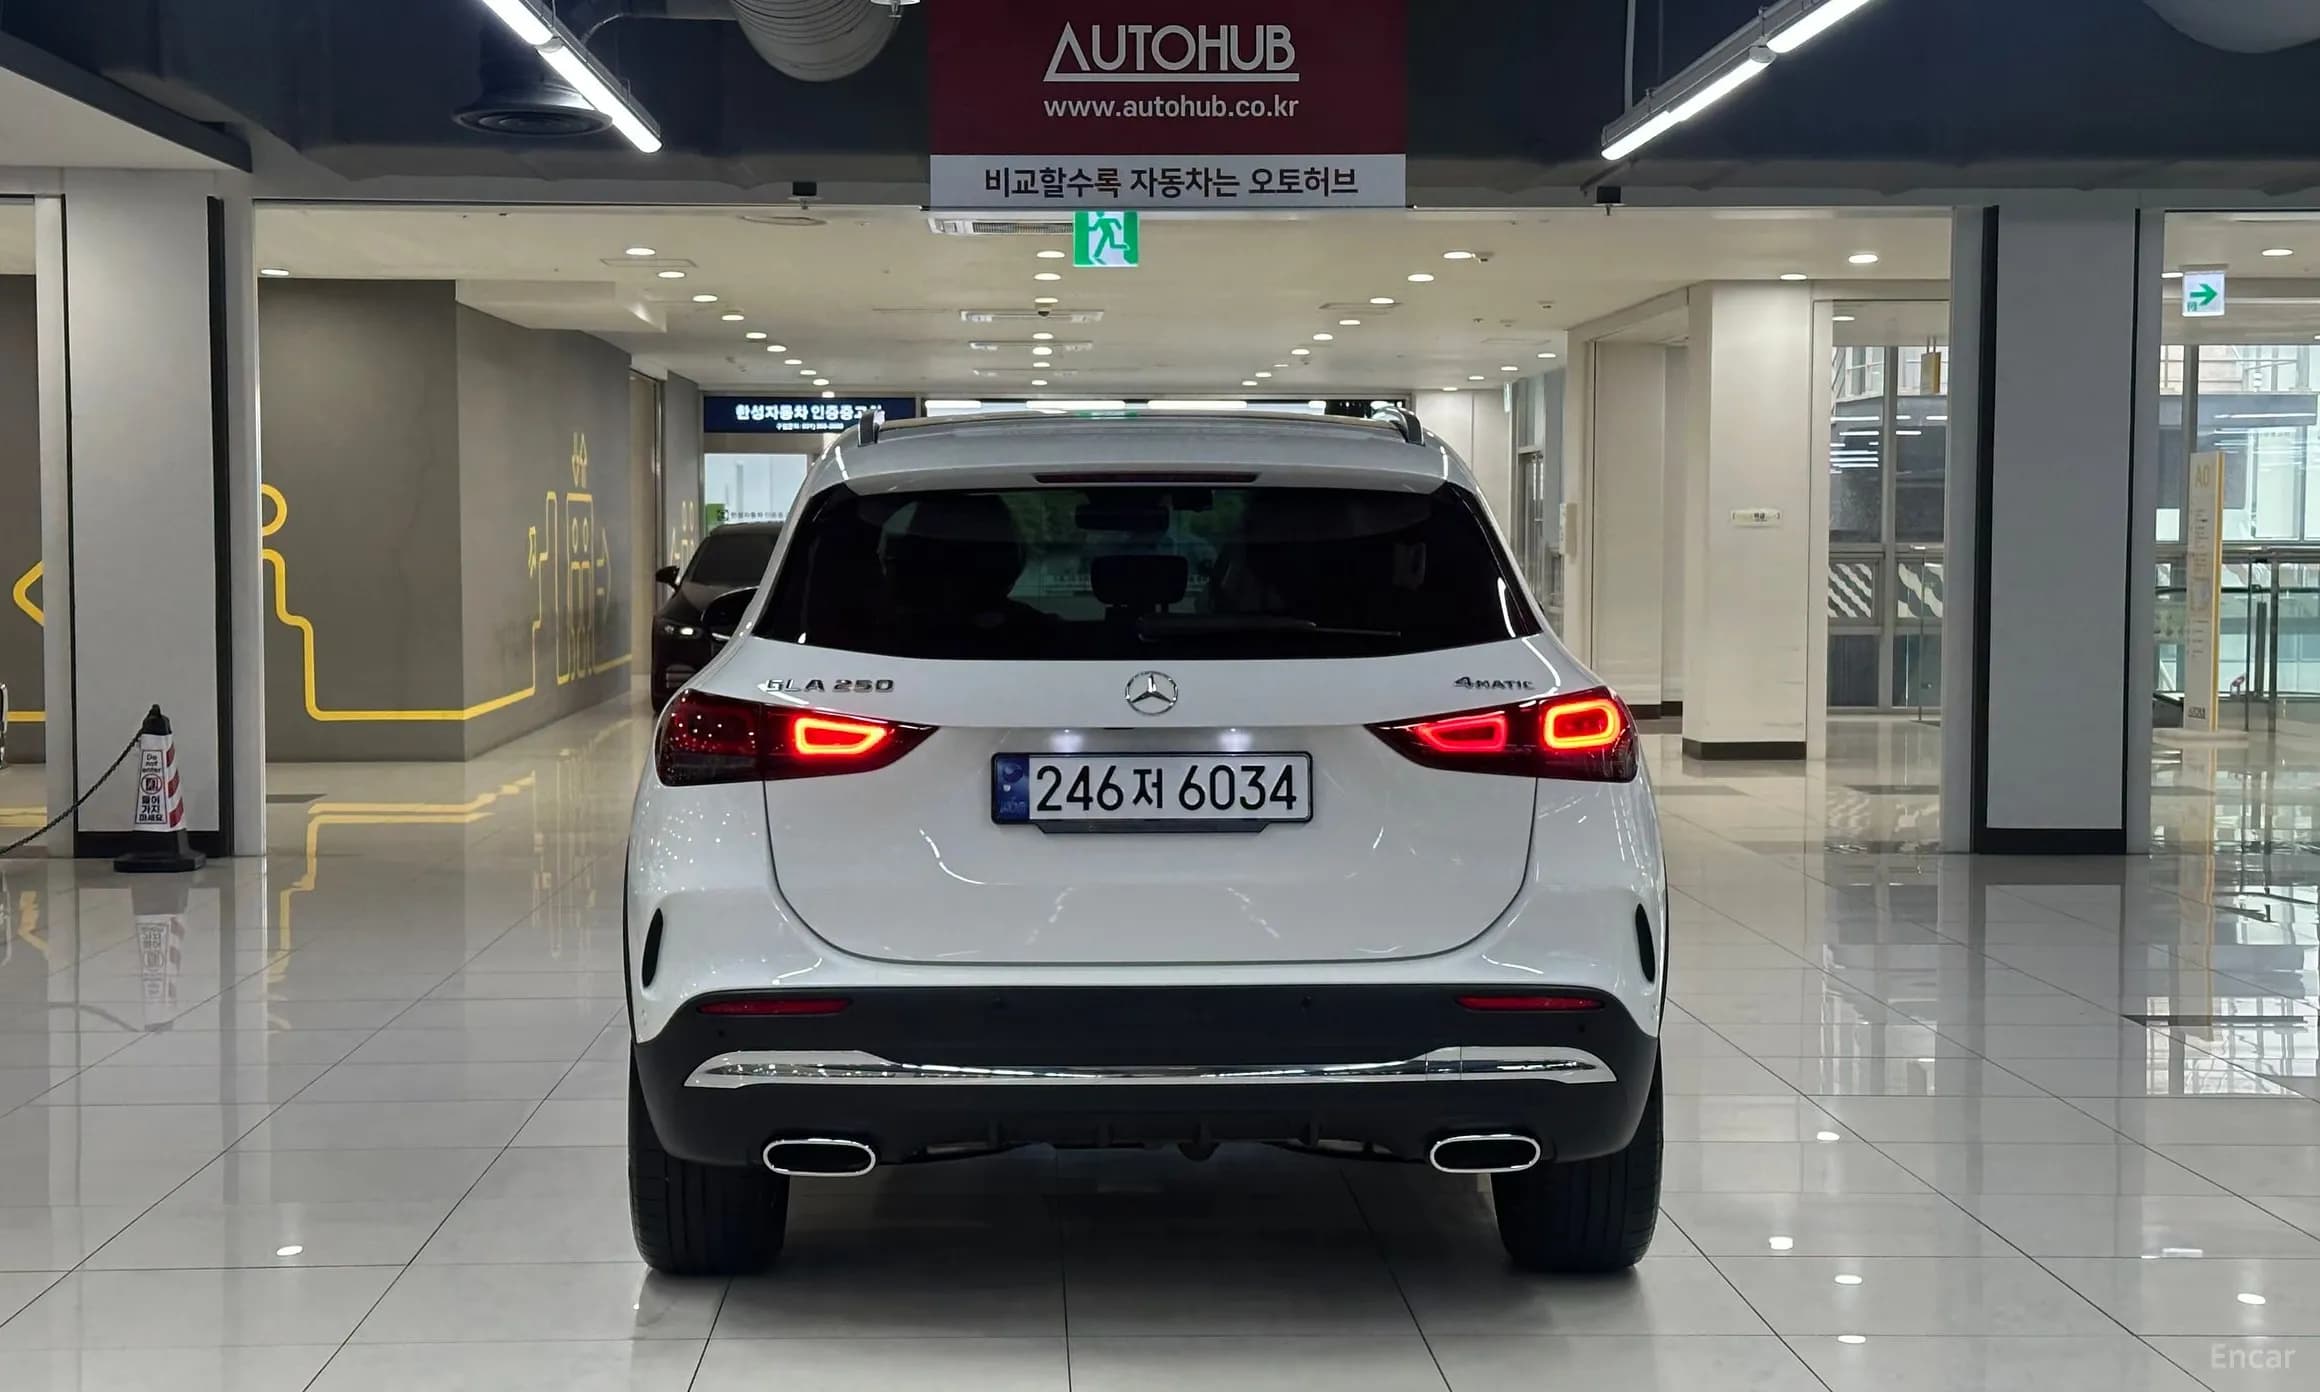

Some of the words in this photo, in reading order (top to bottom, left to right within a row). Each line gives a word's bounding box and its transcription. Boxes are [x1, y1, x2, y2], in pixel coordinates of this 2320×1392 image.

[1043, 21, 1299, 82] AUTOHUB
[1043, 94, 1299, 118] www.autohub.co.kr
[985, 167, 1122, 198] 비교할수록
[1130, 167, 1240, 198] 자동차는
[1249, 167, 1359, 197] 오토허브
[735, 404, 809, 421] 한성자동차
[766, 679, 825, 693] GLA
[832, 679, 895, 693] 250
[1454, 676, 1534, 690] 4MATIC
[1036, 765, 1163, 811] 246저
[1178, 764, 1297, 811] 6034
